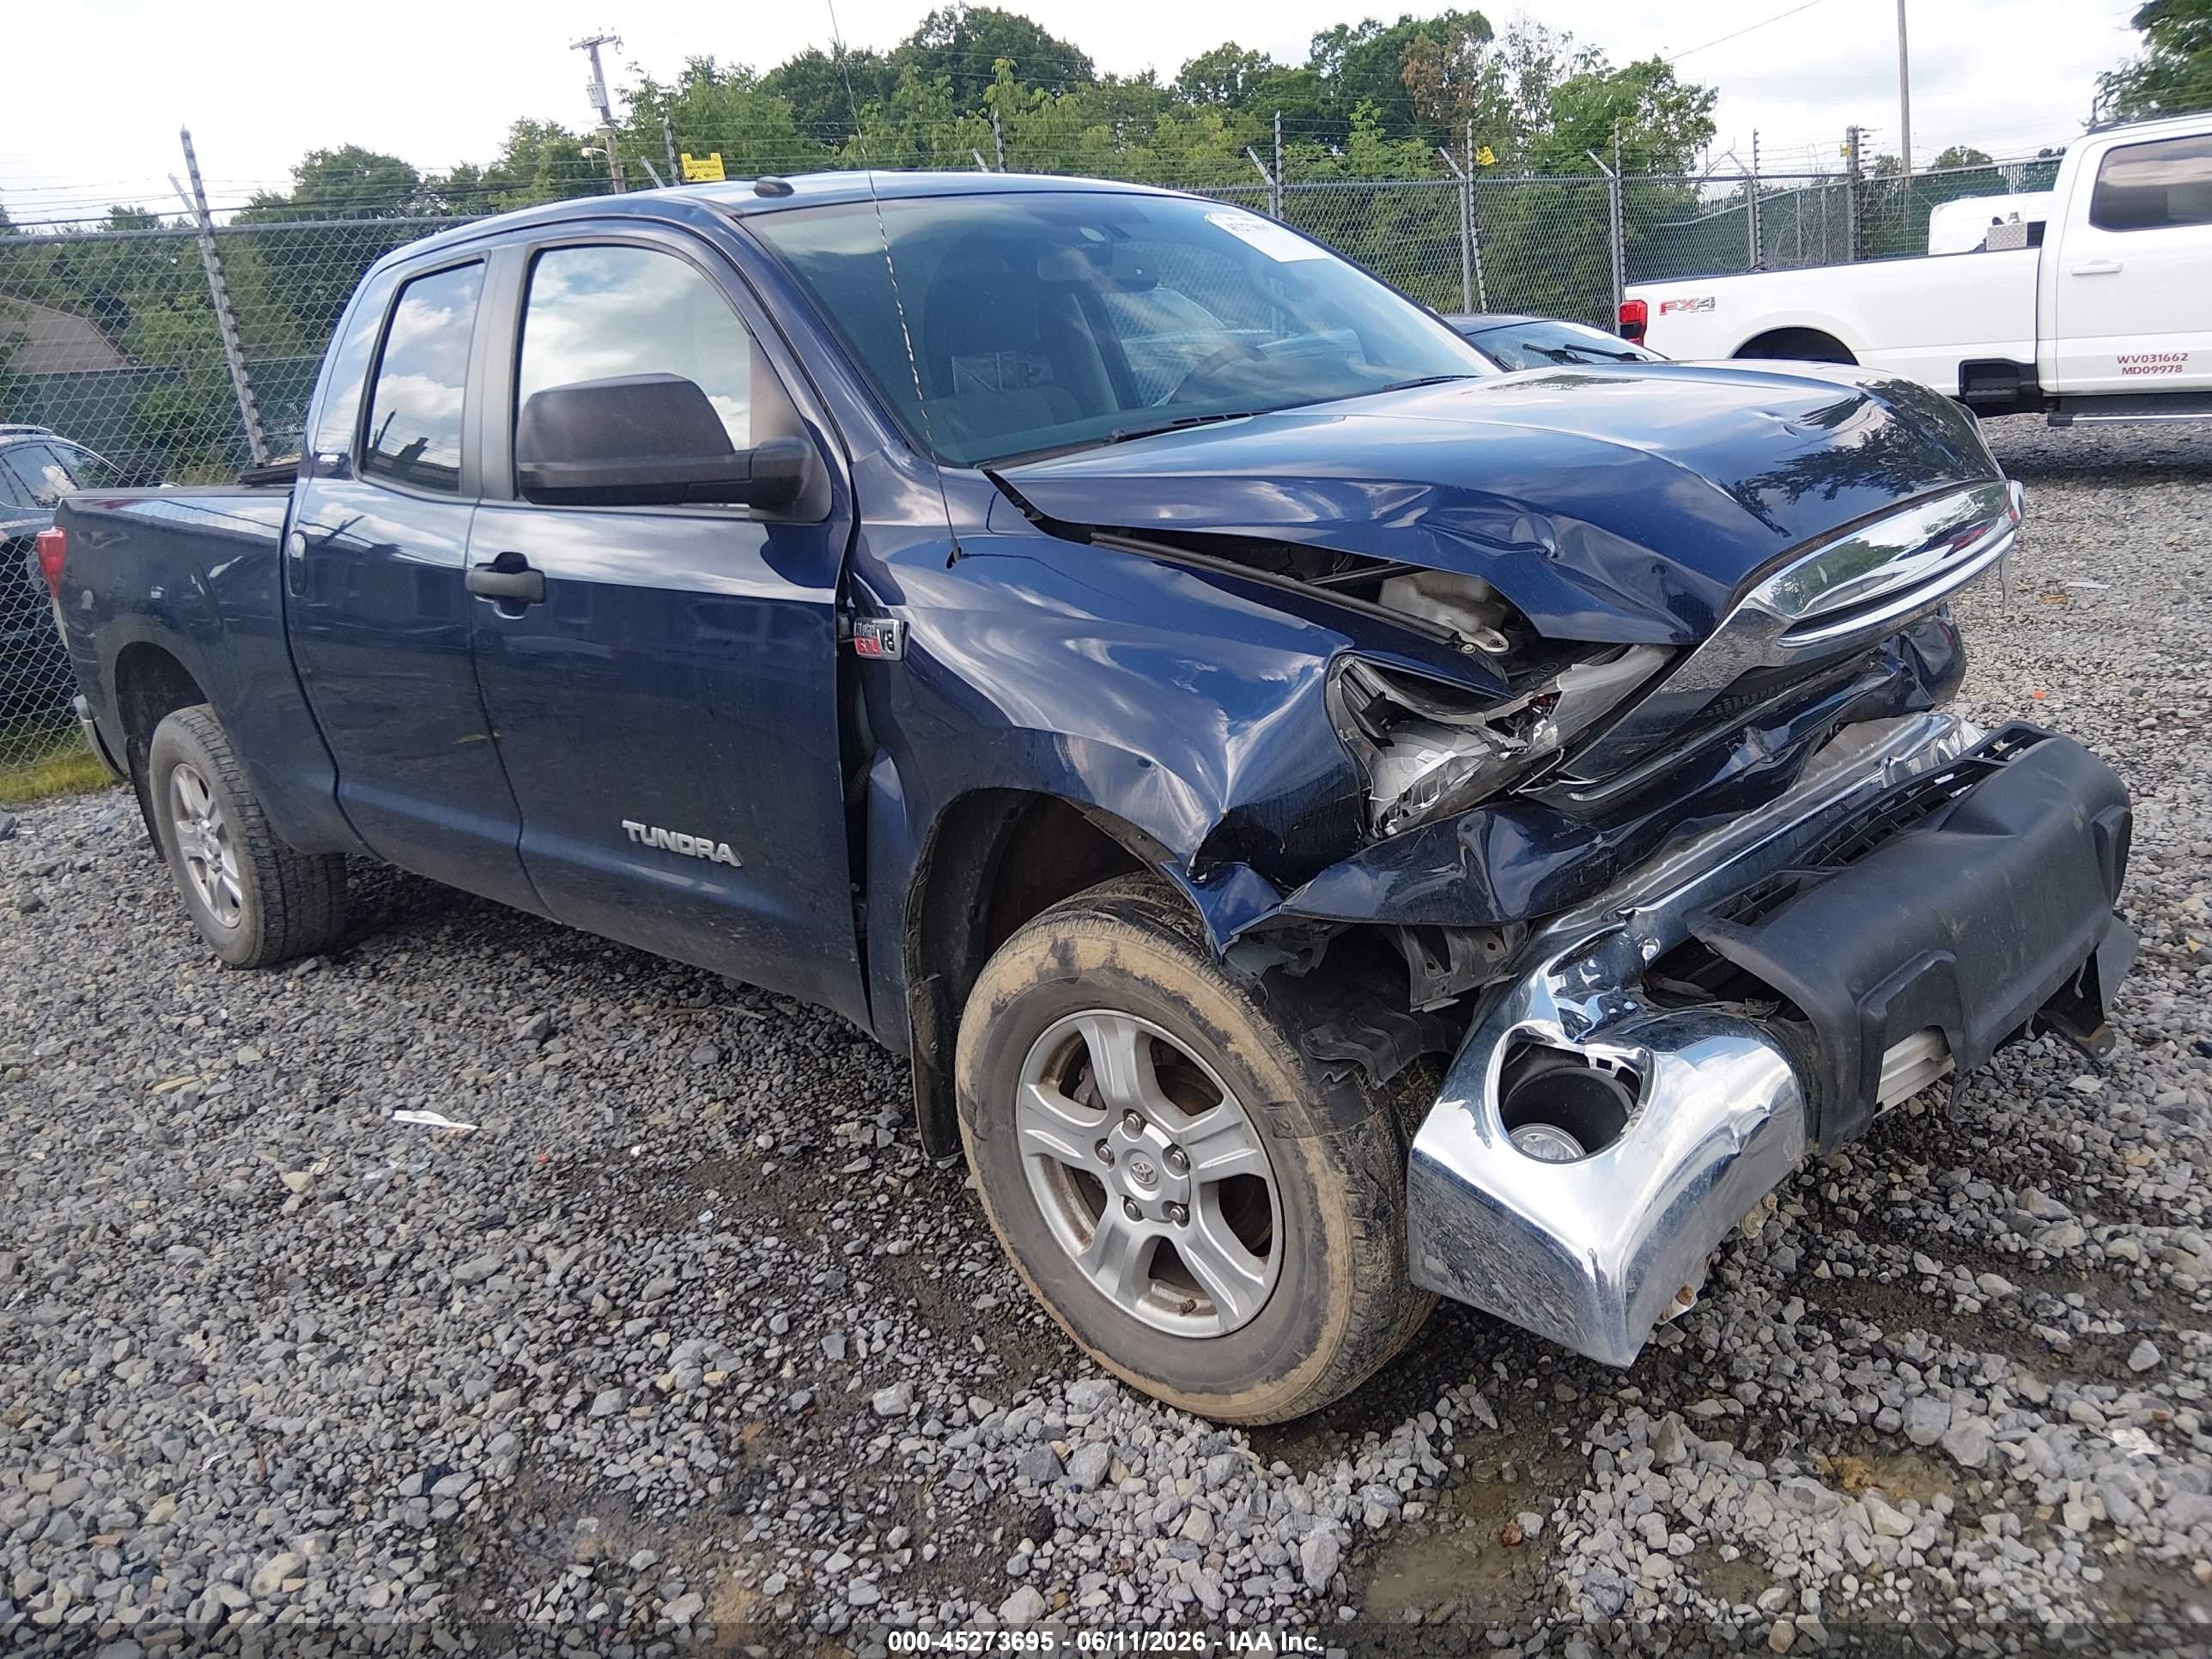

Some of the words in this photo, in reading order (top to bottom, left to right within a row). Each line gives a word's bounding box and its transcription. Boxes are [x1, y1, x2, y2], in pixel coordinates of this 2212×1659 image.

[1659, 296, 1716, 316] FX4
[2117, 352, 2189, 364] WV031662
[2121, 364, 2183, 375] MD09978
[876, 628, 895, 653] V8
[621, 819, 743, 868] TUNDRA
